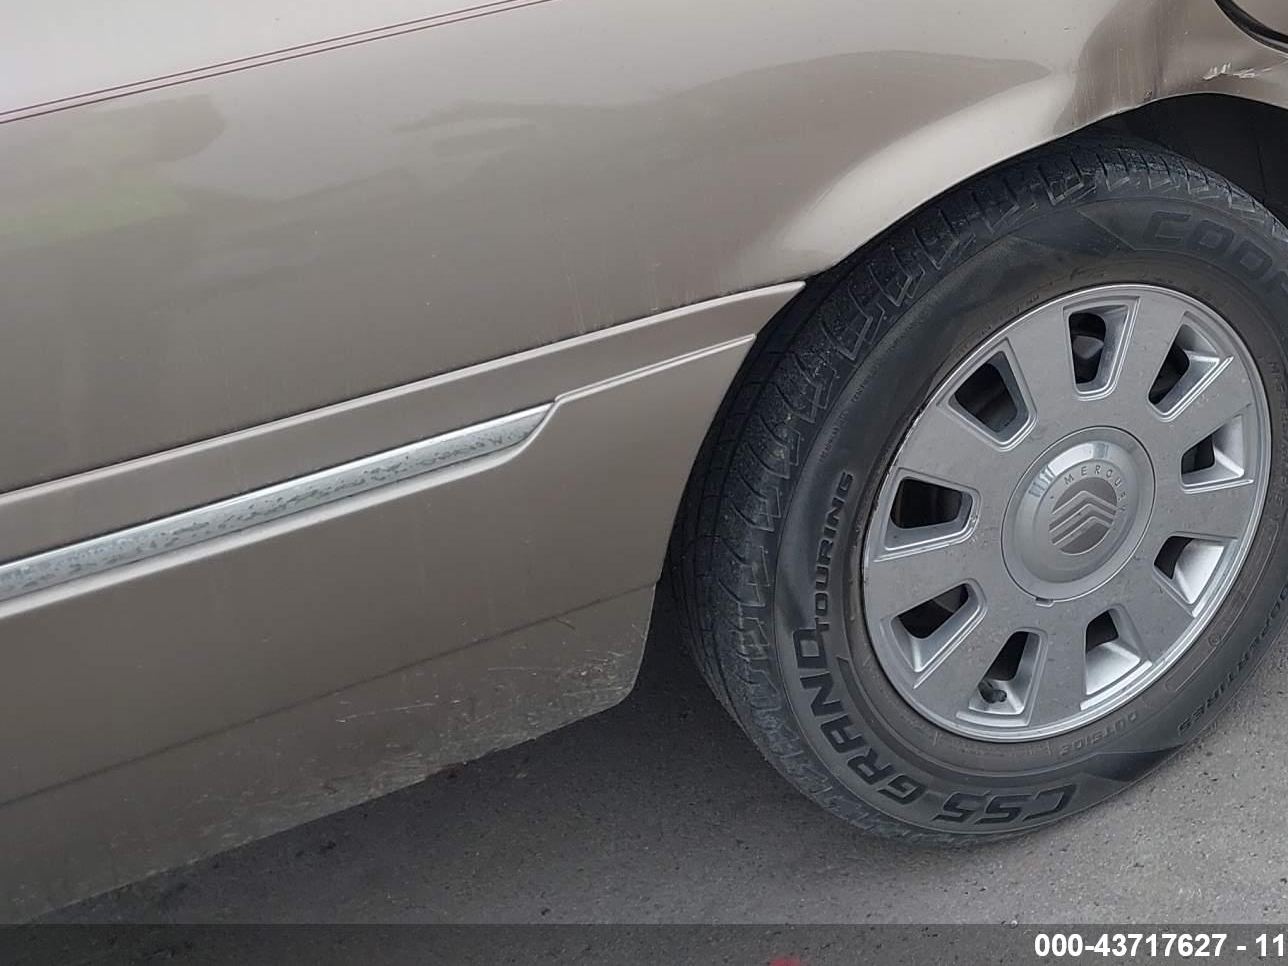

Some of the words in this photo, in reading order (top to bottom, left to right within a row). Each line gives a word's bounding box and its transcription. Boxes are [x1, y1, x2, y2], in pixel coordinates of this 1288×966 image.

[1063, 463, 1129, 512] MERCURY
[814, 471, 855, 632] TOURING
[792, 628, 928, 805] GRAND
[1058, 710, 1138, 757] OUTSIDE
